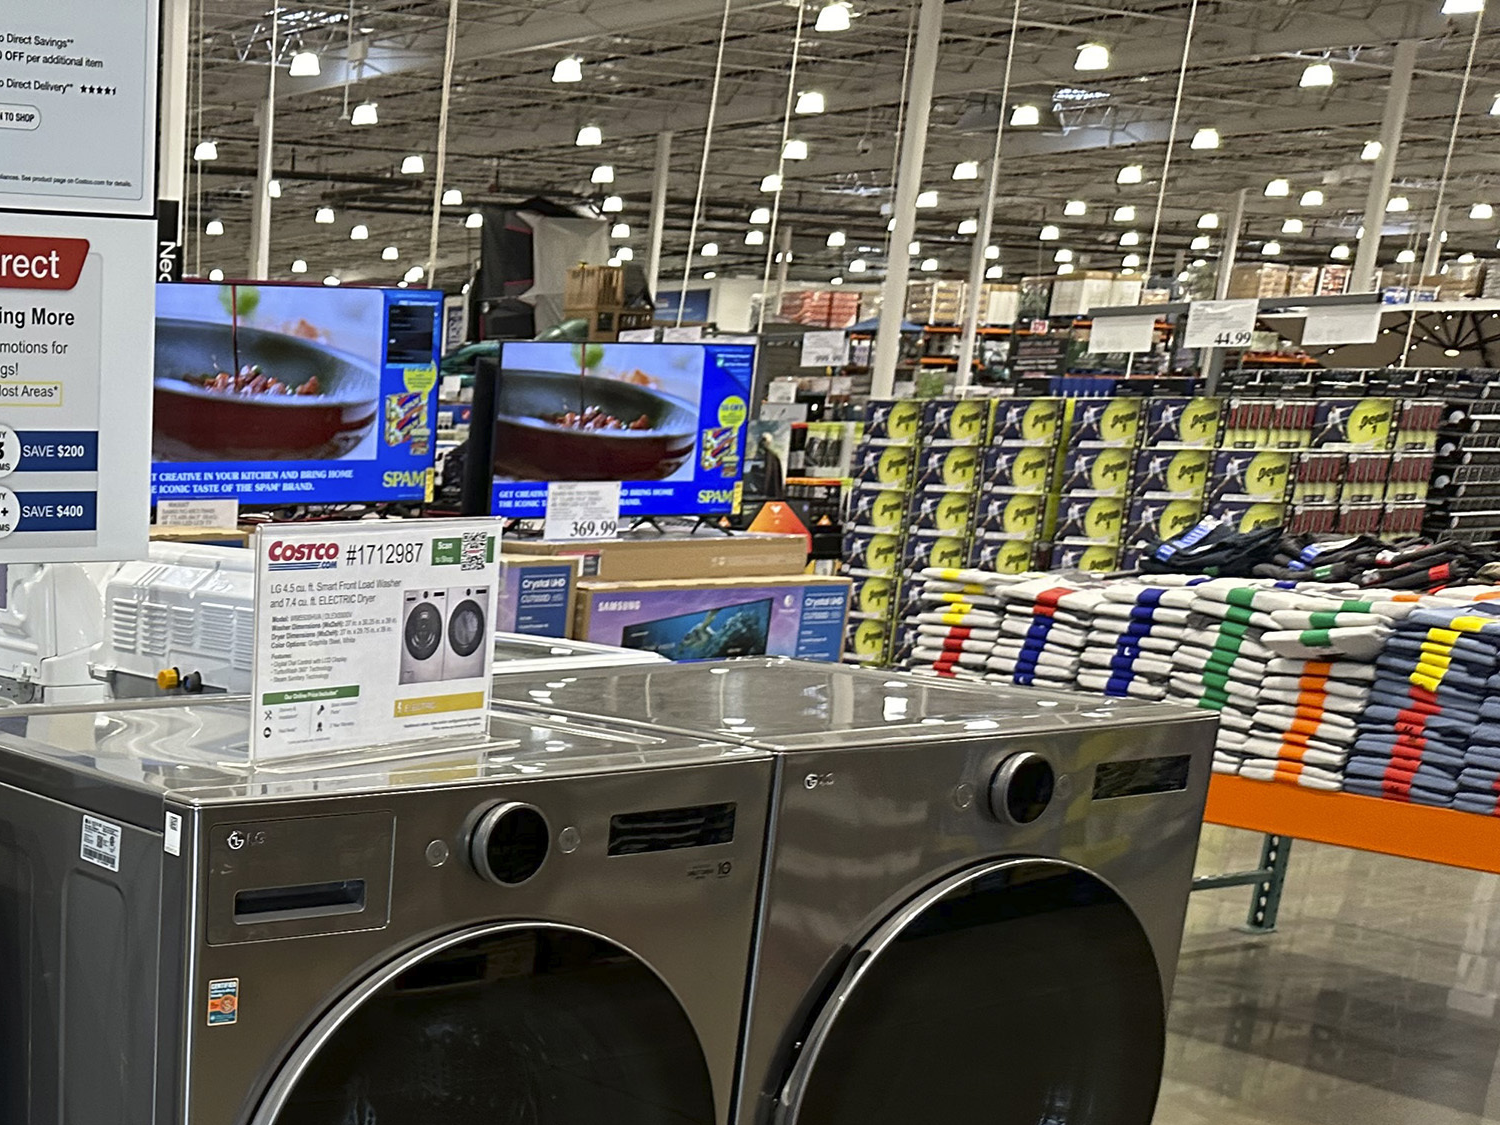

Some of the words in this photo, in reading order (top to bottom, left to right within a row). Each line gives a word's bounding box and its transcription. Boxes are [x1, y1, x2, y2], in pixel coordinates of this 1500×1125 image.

[6, 33, 32, 45] Direct
[5, 50, 25, 62] OFF
[26, 54, 40, 65] per
[42, 54, 84, 67] additional
[85, 57, 104, 68] item
[6, 78, 32, 90] Direct
[4, 111, 14, 122] TO
[15, 112, 35, 123] SHOP
[31, 307, 76, 326] More
[1214, 331, 1252, 345] 44.99
[51, 340, 69, 355] for
[22, 444, 55, 458] SAVE
[57, 444, 85, 458] $200
[159, 472, 202, 483] CREATIVE
[203, 472, 214, 482] IN
[215, 471, 240, 482] YOUR
[240, 470, 279, 482] KITCHEN
[279, 470, 299, 481] AND
[300, 469, 327, 480] BRING
[328, 469, 354, 480] HOME
[382, 470, 426, 488] SPAM
[159, 483, 191, 494] ICONIC
[192, 483, 220, 494] TASTE
[222, 483, 234, 493] OF
[236, 482, 254, 493] THE
[281, 481, 315, 492] BRAND.
[498, 490, 514, 499] GET
[498, 499, 513, 508] THE
[514, 499, 538, 508] ICONIC
[22, 505, 54, 519] SAVE
[56, 504, 84, 518] $400
[570, 521, 617, 537] 369.99
[268, 540, 340, 562] COSTCO
[437, 541, 453, 550] Scan
[346, 543, 423, 566] #1712987
[270, 584, 282, 594] LG
[283, 583, 295, 593] 4.5
[316, 581, 338, 592] Smart
[338, 580, 357, 591] Front
[358, 579, 375, 590] Load
[376, 578, 402, 589] Washer
[521, 578, 550, 591] Crystal
[269, 598, 284, 609] and
[285, 597, 297, 608] 7.4
[318, 594, 357, 606] ELECTRIC
[357, 593, 376, 605] Dryer
[597, 599, 641, 613] SAMSUNG
